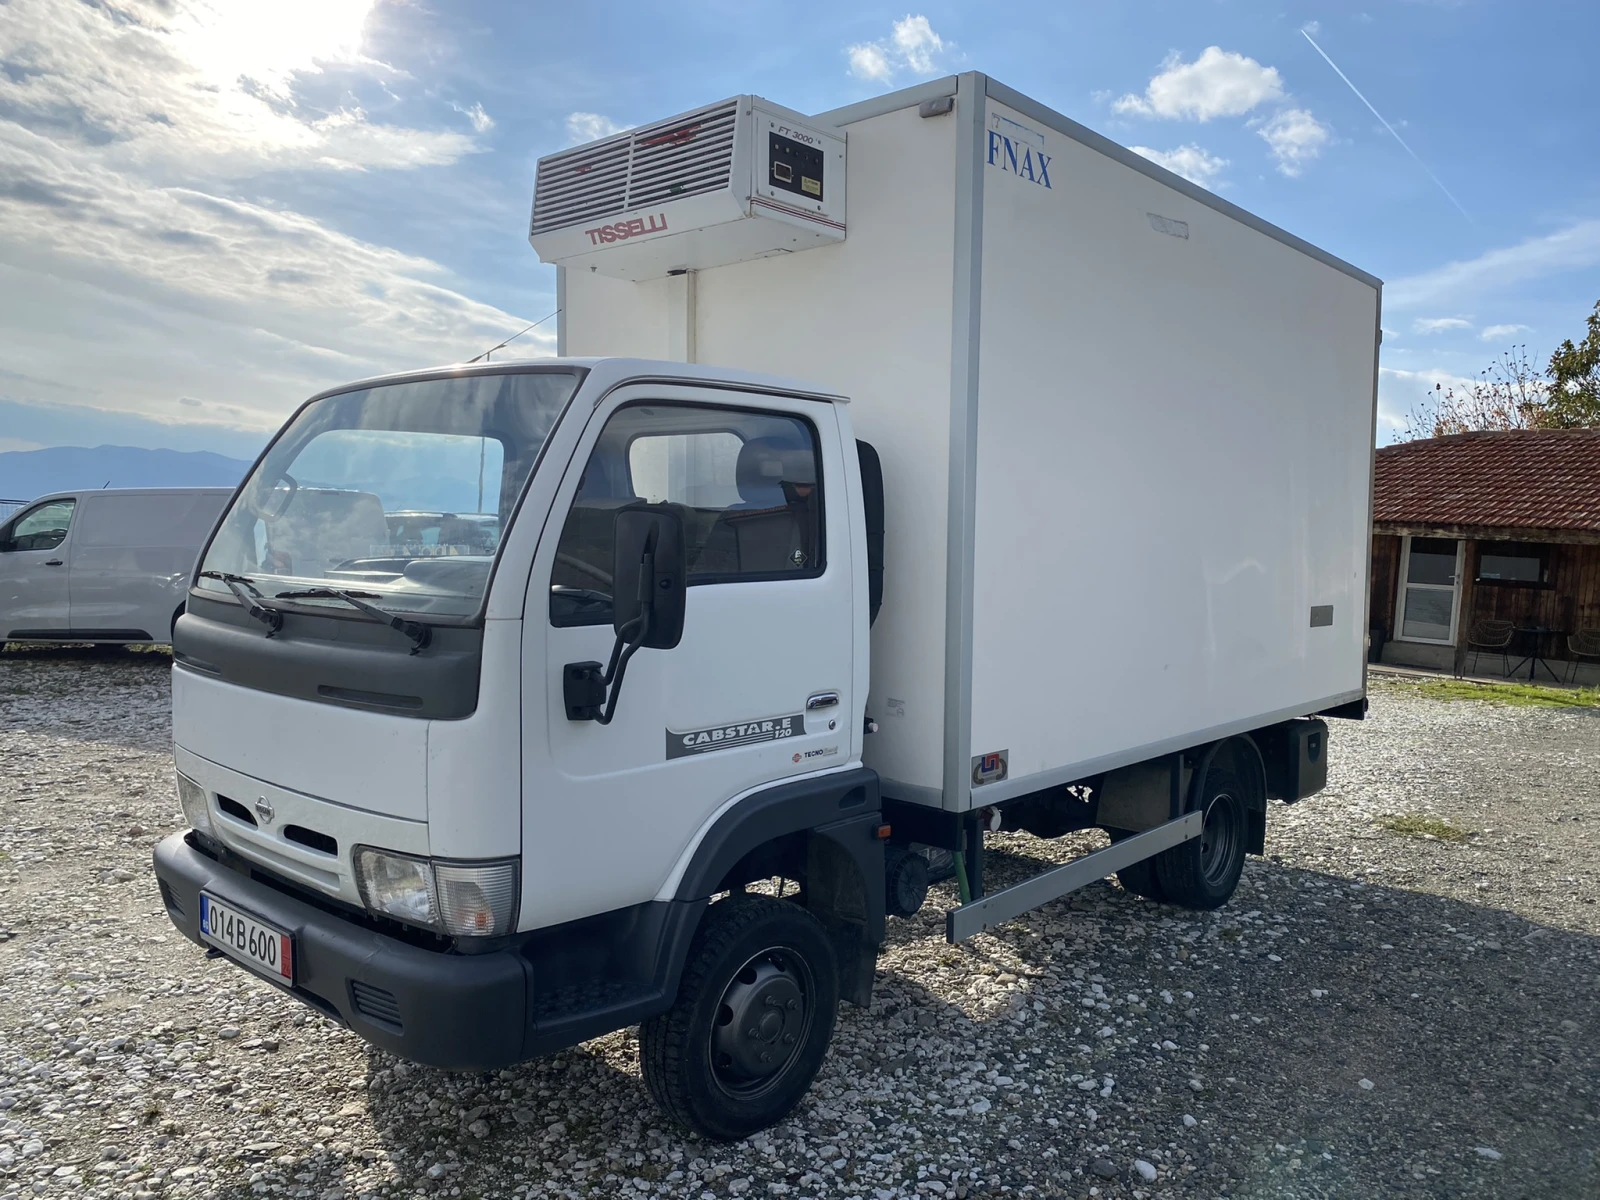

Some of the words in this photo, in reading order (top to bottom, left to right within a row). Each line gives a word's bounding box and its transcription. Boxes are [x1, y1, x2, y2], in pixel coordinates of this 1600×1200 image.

[778, 126, 791, 136] FT
[792, 131, 814, 145] 3000
[987, 129, 1052, 189] FNAX
[585, 213, 668, 245] TISSELLI
[775, 728, 792, 739] 120
[210, 905, 276, 966] 014B600
